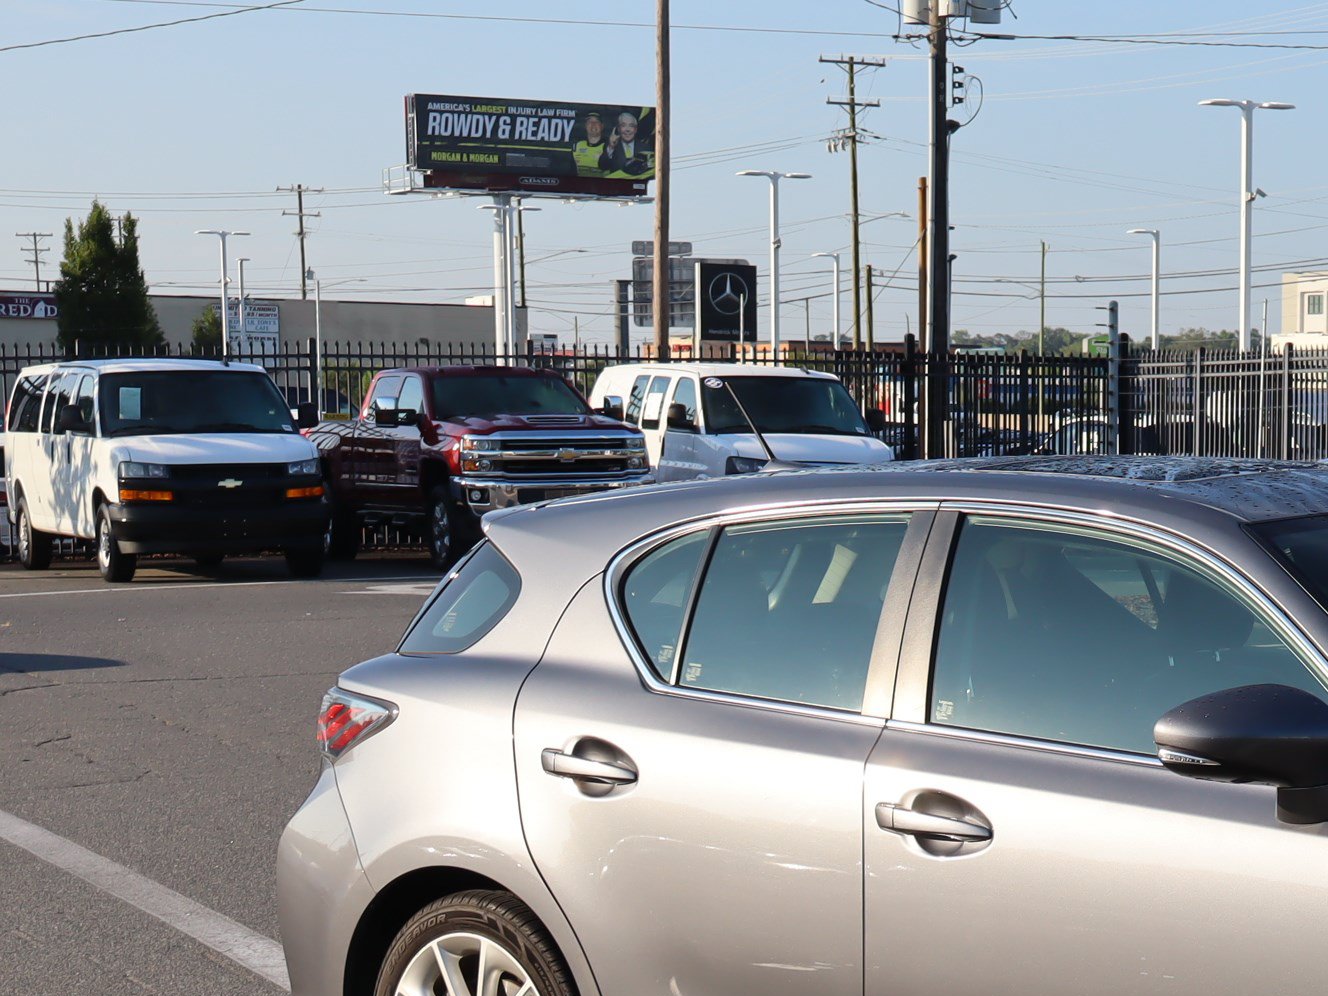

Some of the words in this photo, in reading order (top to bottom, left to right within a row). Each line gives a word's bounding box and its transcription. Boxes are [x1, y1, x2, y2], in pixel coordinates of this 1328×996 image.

[427, 102, 470, 112] AMERICA'S
[471, 105, 507, 114] LARGEST
[508, 106, 537, 116] INJURY
[538, 108, 555, 116] LAW
[556, 109, 576, 117] FIRM
[427, 112, 497, 139] ROWDY
[497, 115, 511, 140] &
[514, 116, 576, 143] READY
[431, 151, 461, 162] MORGAN
[462, 153, 468, 162] &
[469, 153, 499, 164] MORGAN
[0, 303, 31, 317] RED
[387, 913, 447, 975] ENDEAVOR
